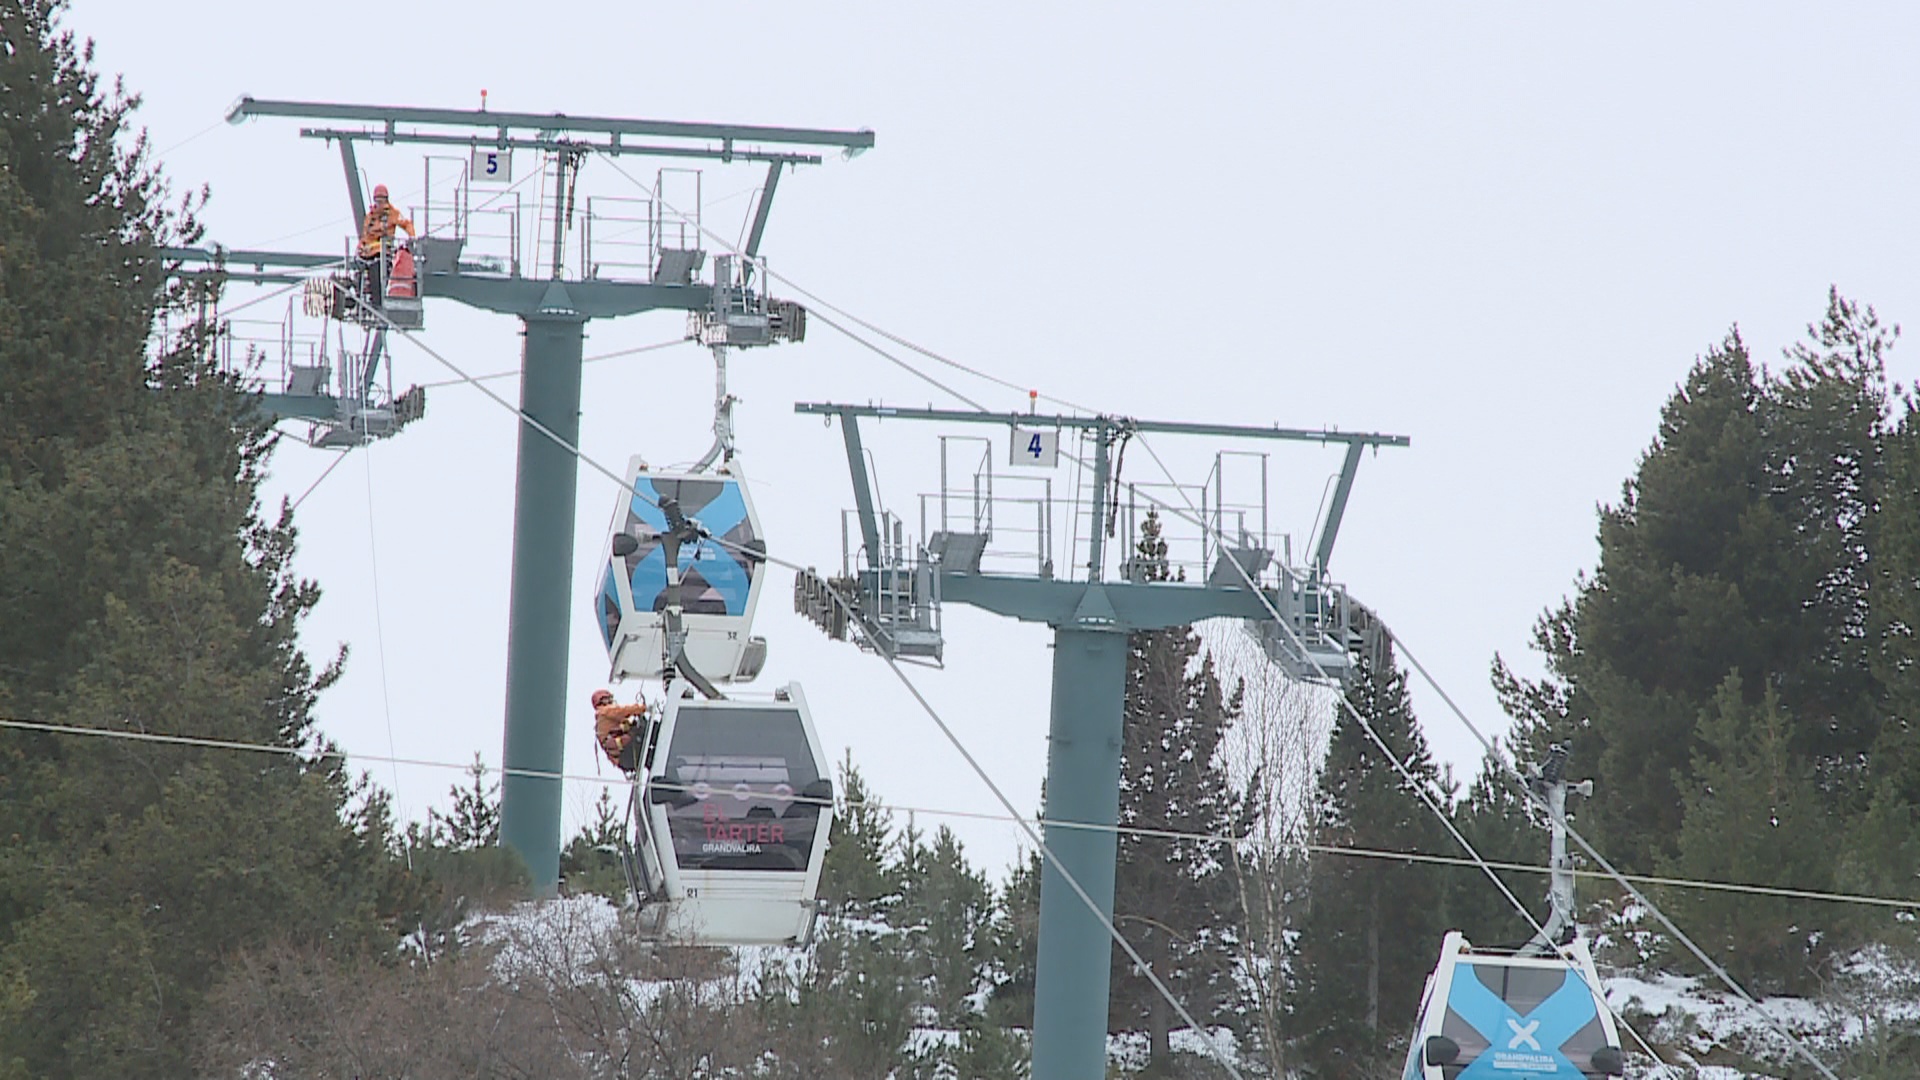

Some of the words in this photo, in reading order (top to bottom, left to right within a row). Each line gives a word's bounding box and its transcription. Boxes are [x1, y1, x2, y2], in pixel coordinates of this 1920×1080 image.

[486, 153, 498, 175] 5
[1027, 433, 1042, 458] 4
[703, 803, 730, 822] EL
[702, 843, 762, 853] GRANDVALIRA
